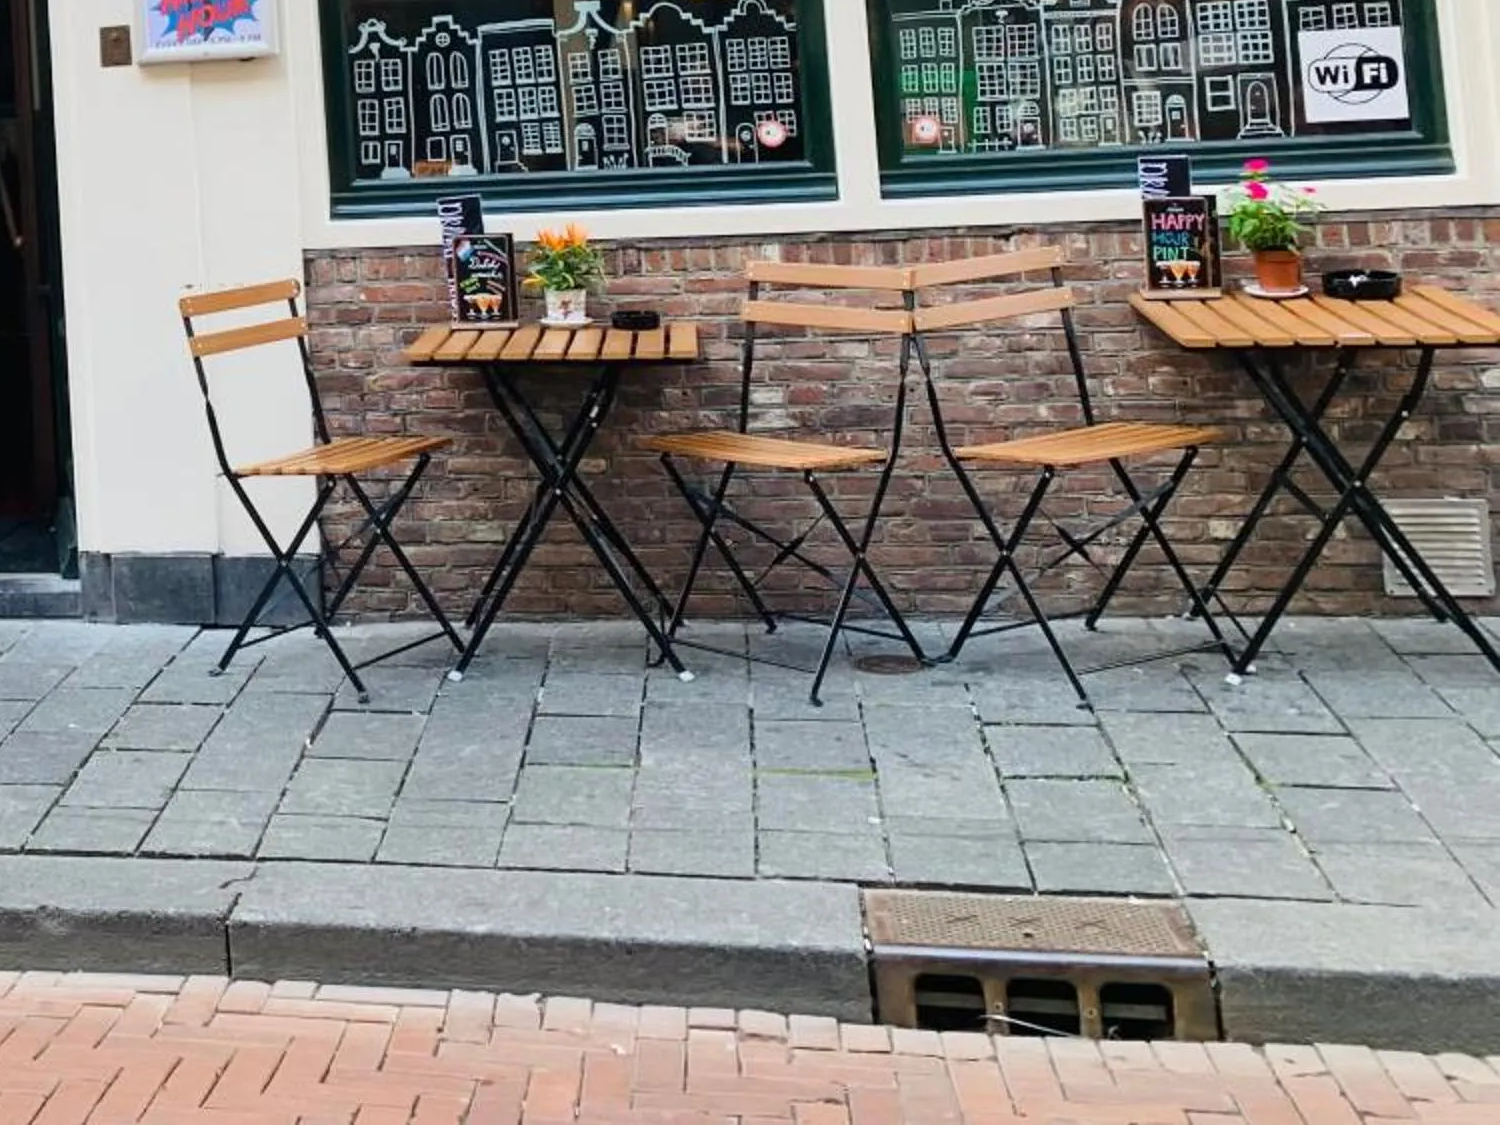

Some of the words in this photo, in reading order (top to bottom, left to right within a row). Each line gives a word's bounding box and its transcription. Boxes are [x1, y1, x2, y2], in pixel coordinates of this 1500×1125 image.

[1151, 213, 1205, 231] HAPPY
[1152, 231, 1190, 246] HOUR
[1153, 246, 1189, 261] PINT
